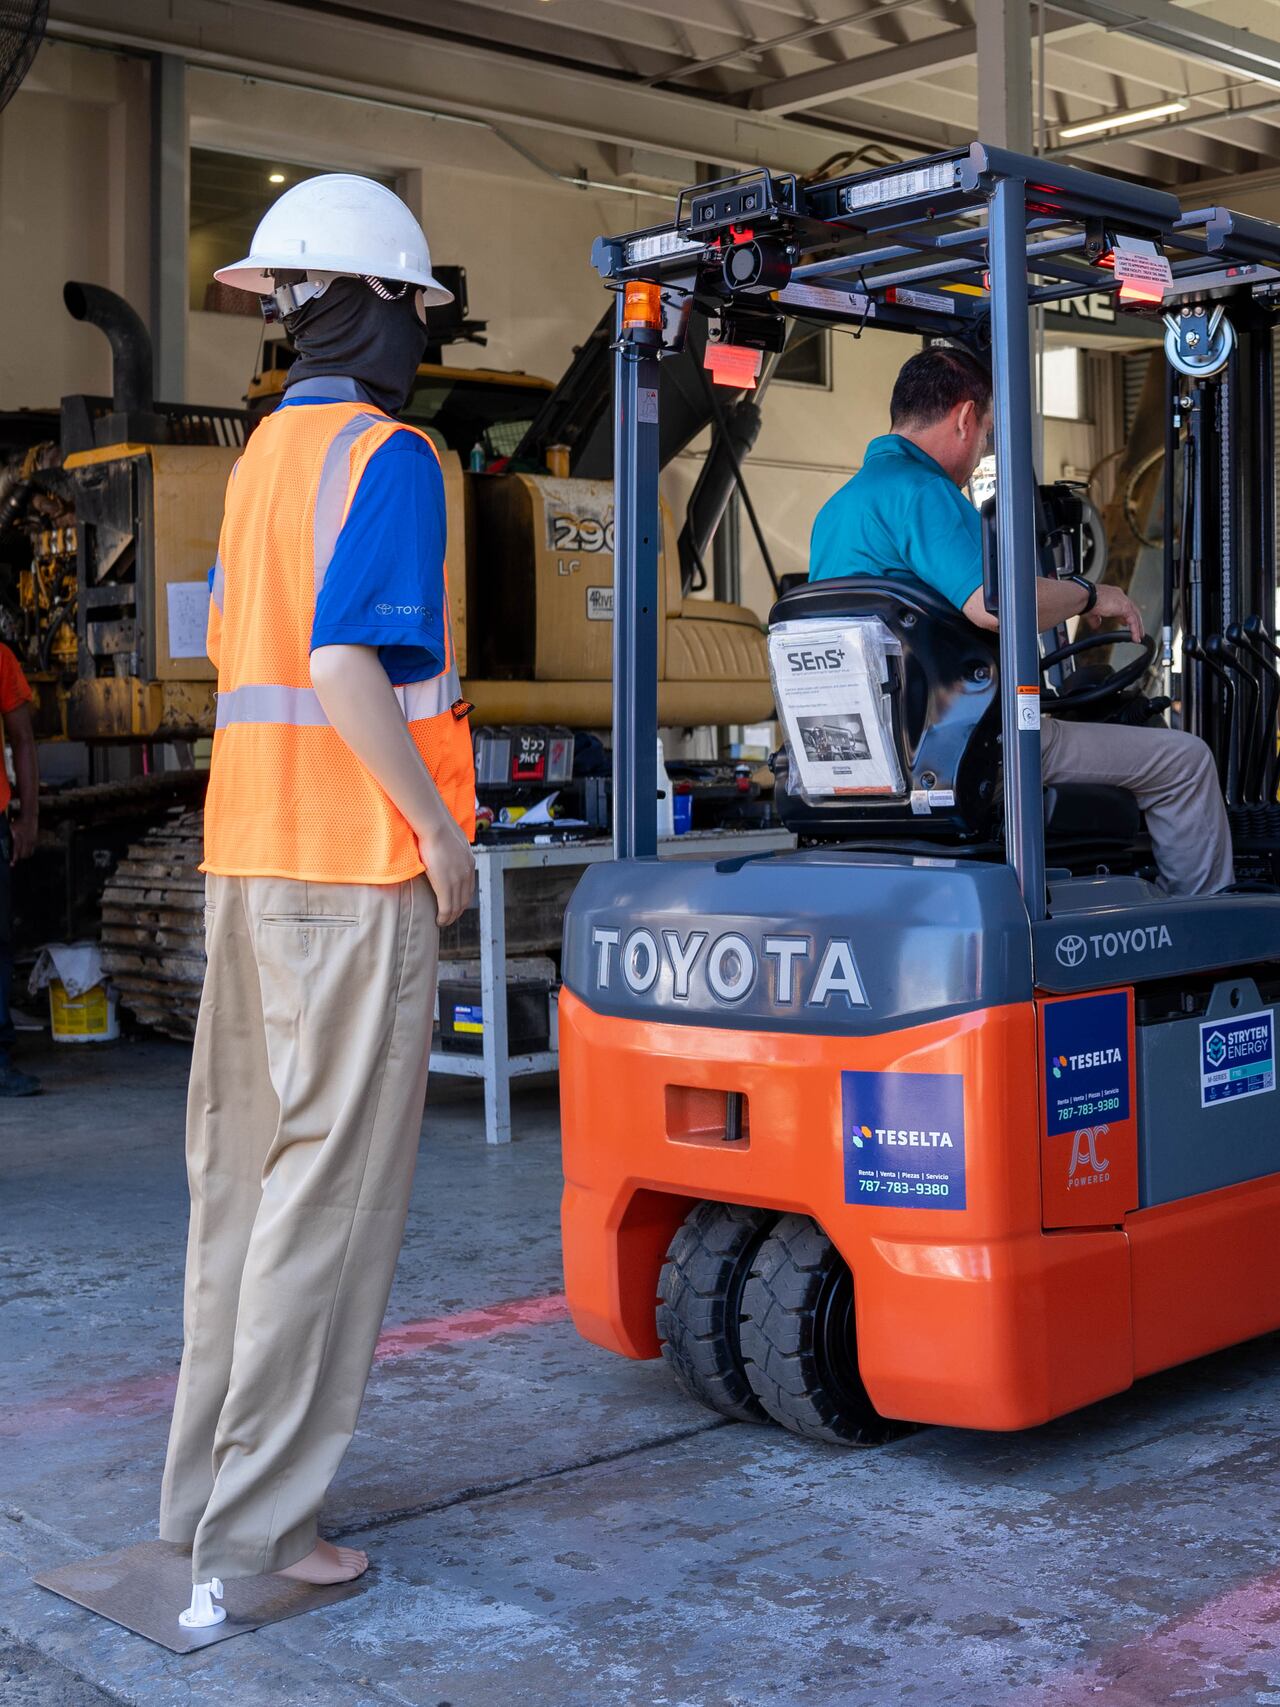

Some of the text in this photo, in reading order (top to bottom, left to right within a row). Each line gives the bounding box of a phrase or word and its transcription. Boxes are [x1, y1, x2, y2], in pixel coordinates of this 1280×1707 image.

[1090, 925, 1172, 958] TOYOTA
[593, 927, 870, 1008] TOYOTA
[1228, 1025, 1268, 1045] STRYTEN
[1069, 1048, 1121, 1070] TESELTA
[1228, 1039, 1269, 1059] ENERGY
[1057, 1098, 1070, 1106] Renta
[1073, 1095, 1085, 1103] Venta
[1104, 1087, 1119, 1096] Servicio
[1057, 1097, 1120, 1121] 787-783-9380
[875, 1129, 953, 1147] TESELTA
[859, 1180, 949, 1195] 787-783-9380
[1068, 1172, 1110, 1188] POWERED
